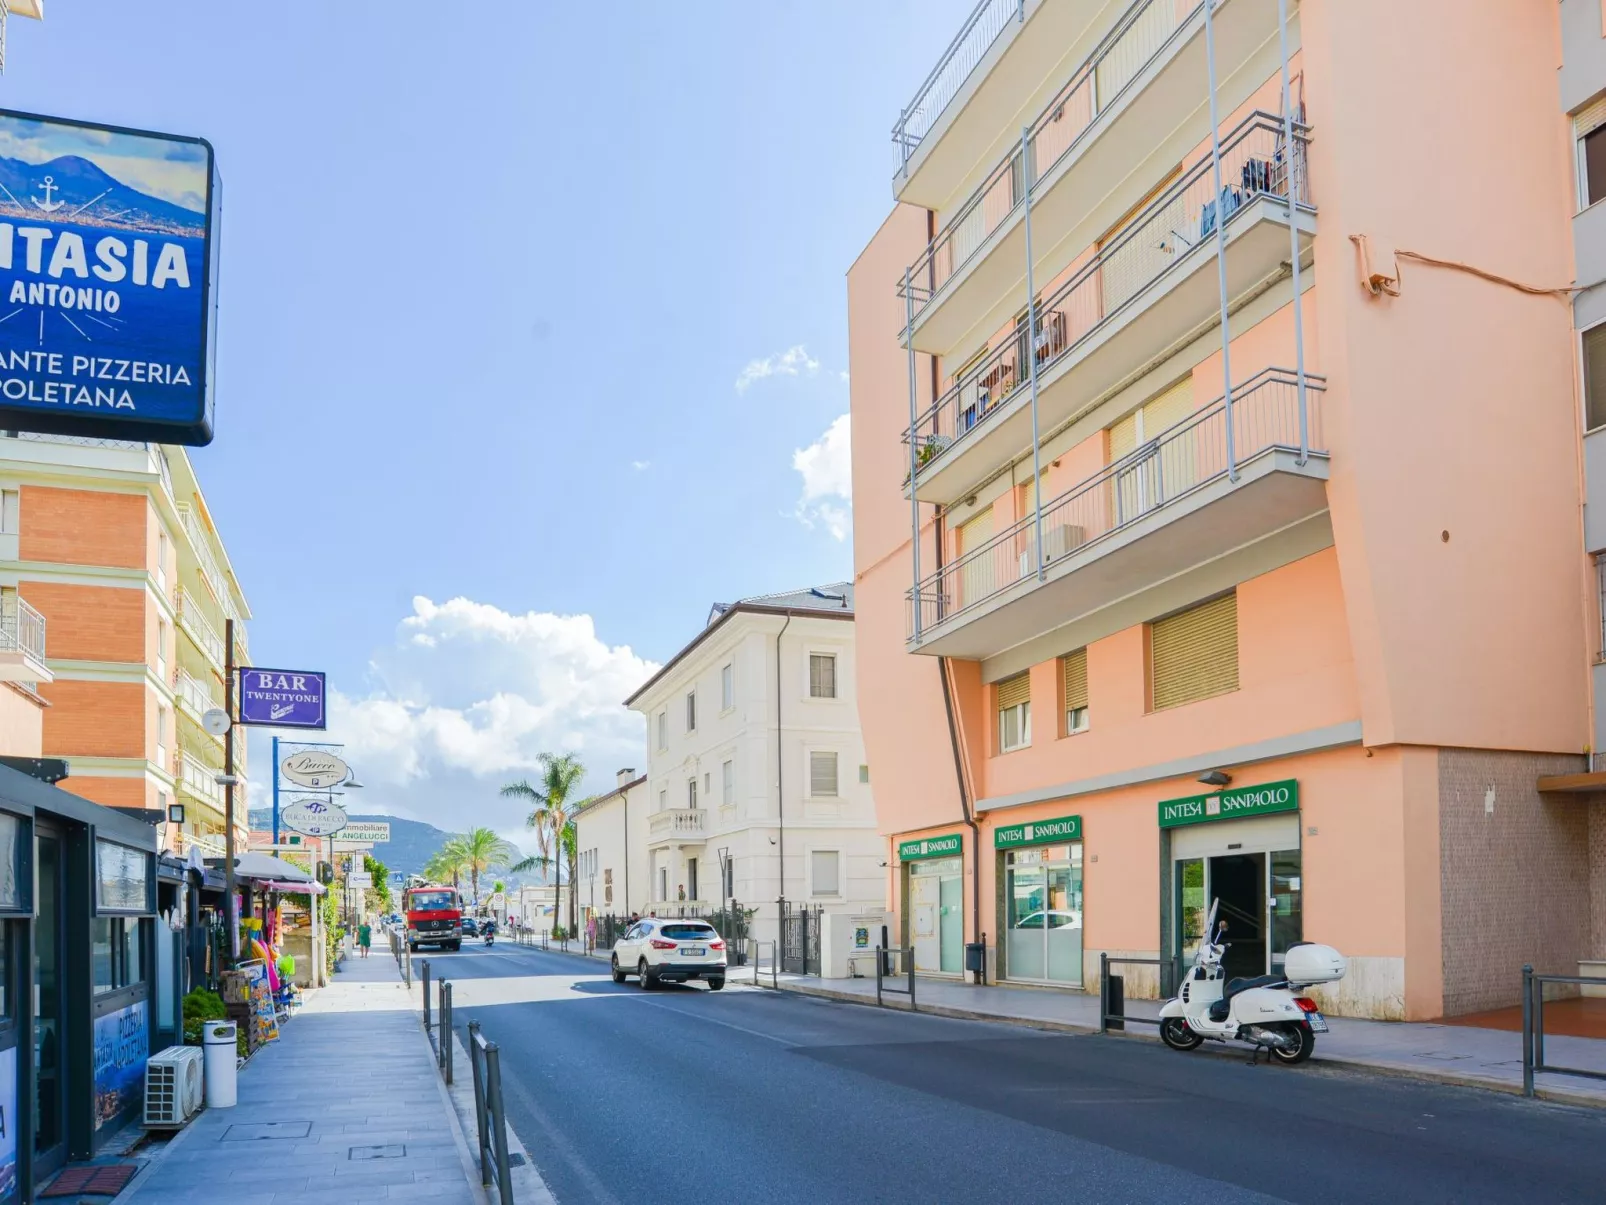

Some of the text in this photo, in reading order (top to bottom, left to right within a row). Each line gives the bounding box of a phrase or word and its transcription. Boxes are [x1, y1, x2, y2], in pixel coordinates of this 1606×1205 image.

[10, 280, 120, 313] ANTONIO
[72, 355, 192, 386] PIZZERIA
[0, 378, 136, 410] OLETANA
[258, 674, 307, 691] BAR
[246, 691, 319, 703] TWENTYONE
[1164, 787, 1289, 820] INTESA SANPAOLO
[342, 832, 388, 840] ANGELUCCI
[998, 821, 1076, 842] INTESA SANPAOLO
[902, 839, 958, 855] INTESA SANPAOLO
